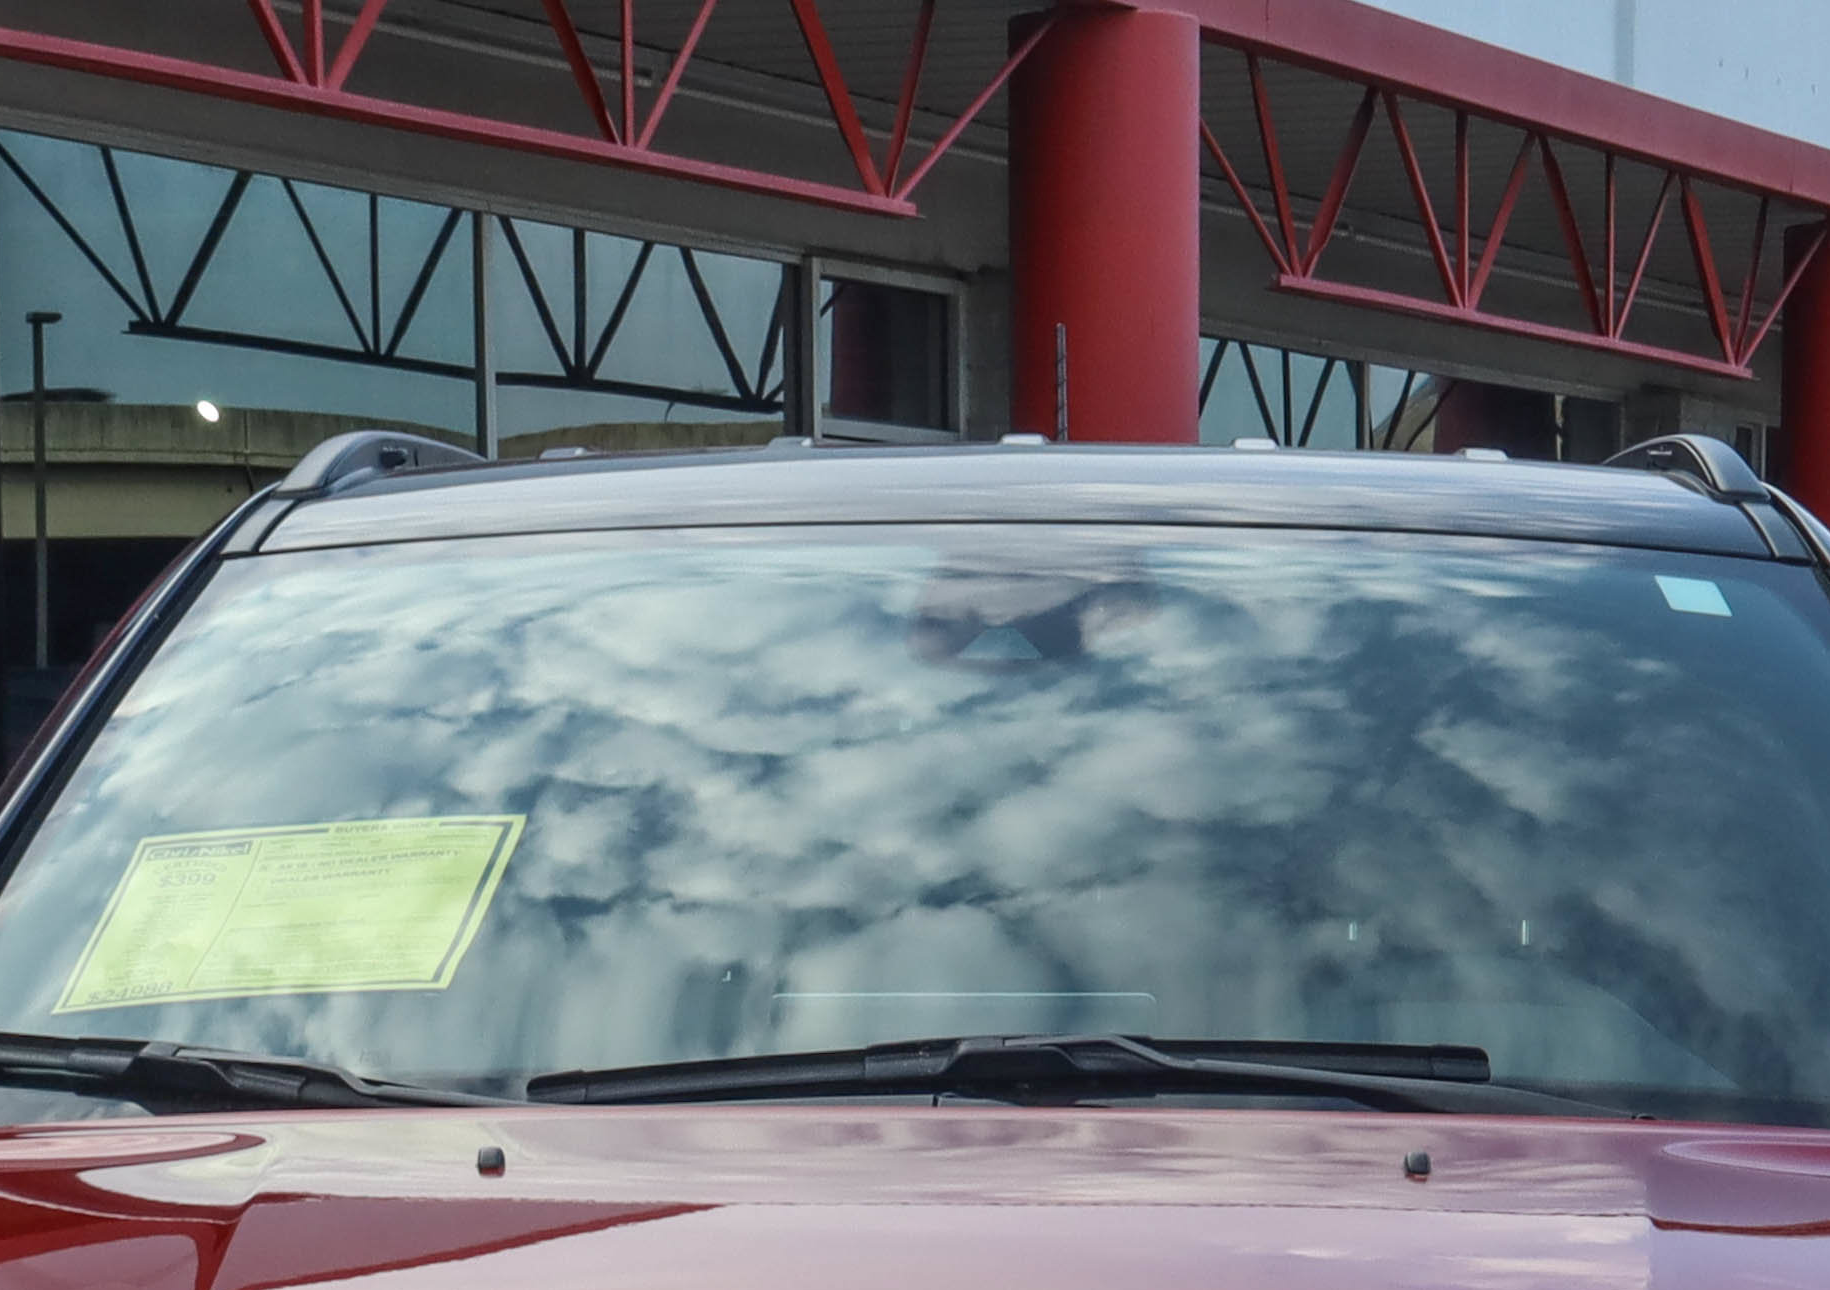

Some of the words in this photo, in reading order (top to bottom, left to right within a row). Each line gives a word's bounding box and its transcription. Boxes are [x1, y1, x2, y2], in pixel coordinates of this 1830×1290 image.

[338, 854, 388, 866] DEALER
[390, 848, 460, 861] WARRANTY
[158, 872, 217, 888] $399
[321, 867, 391, 880] WARRANTY
